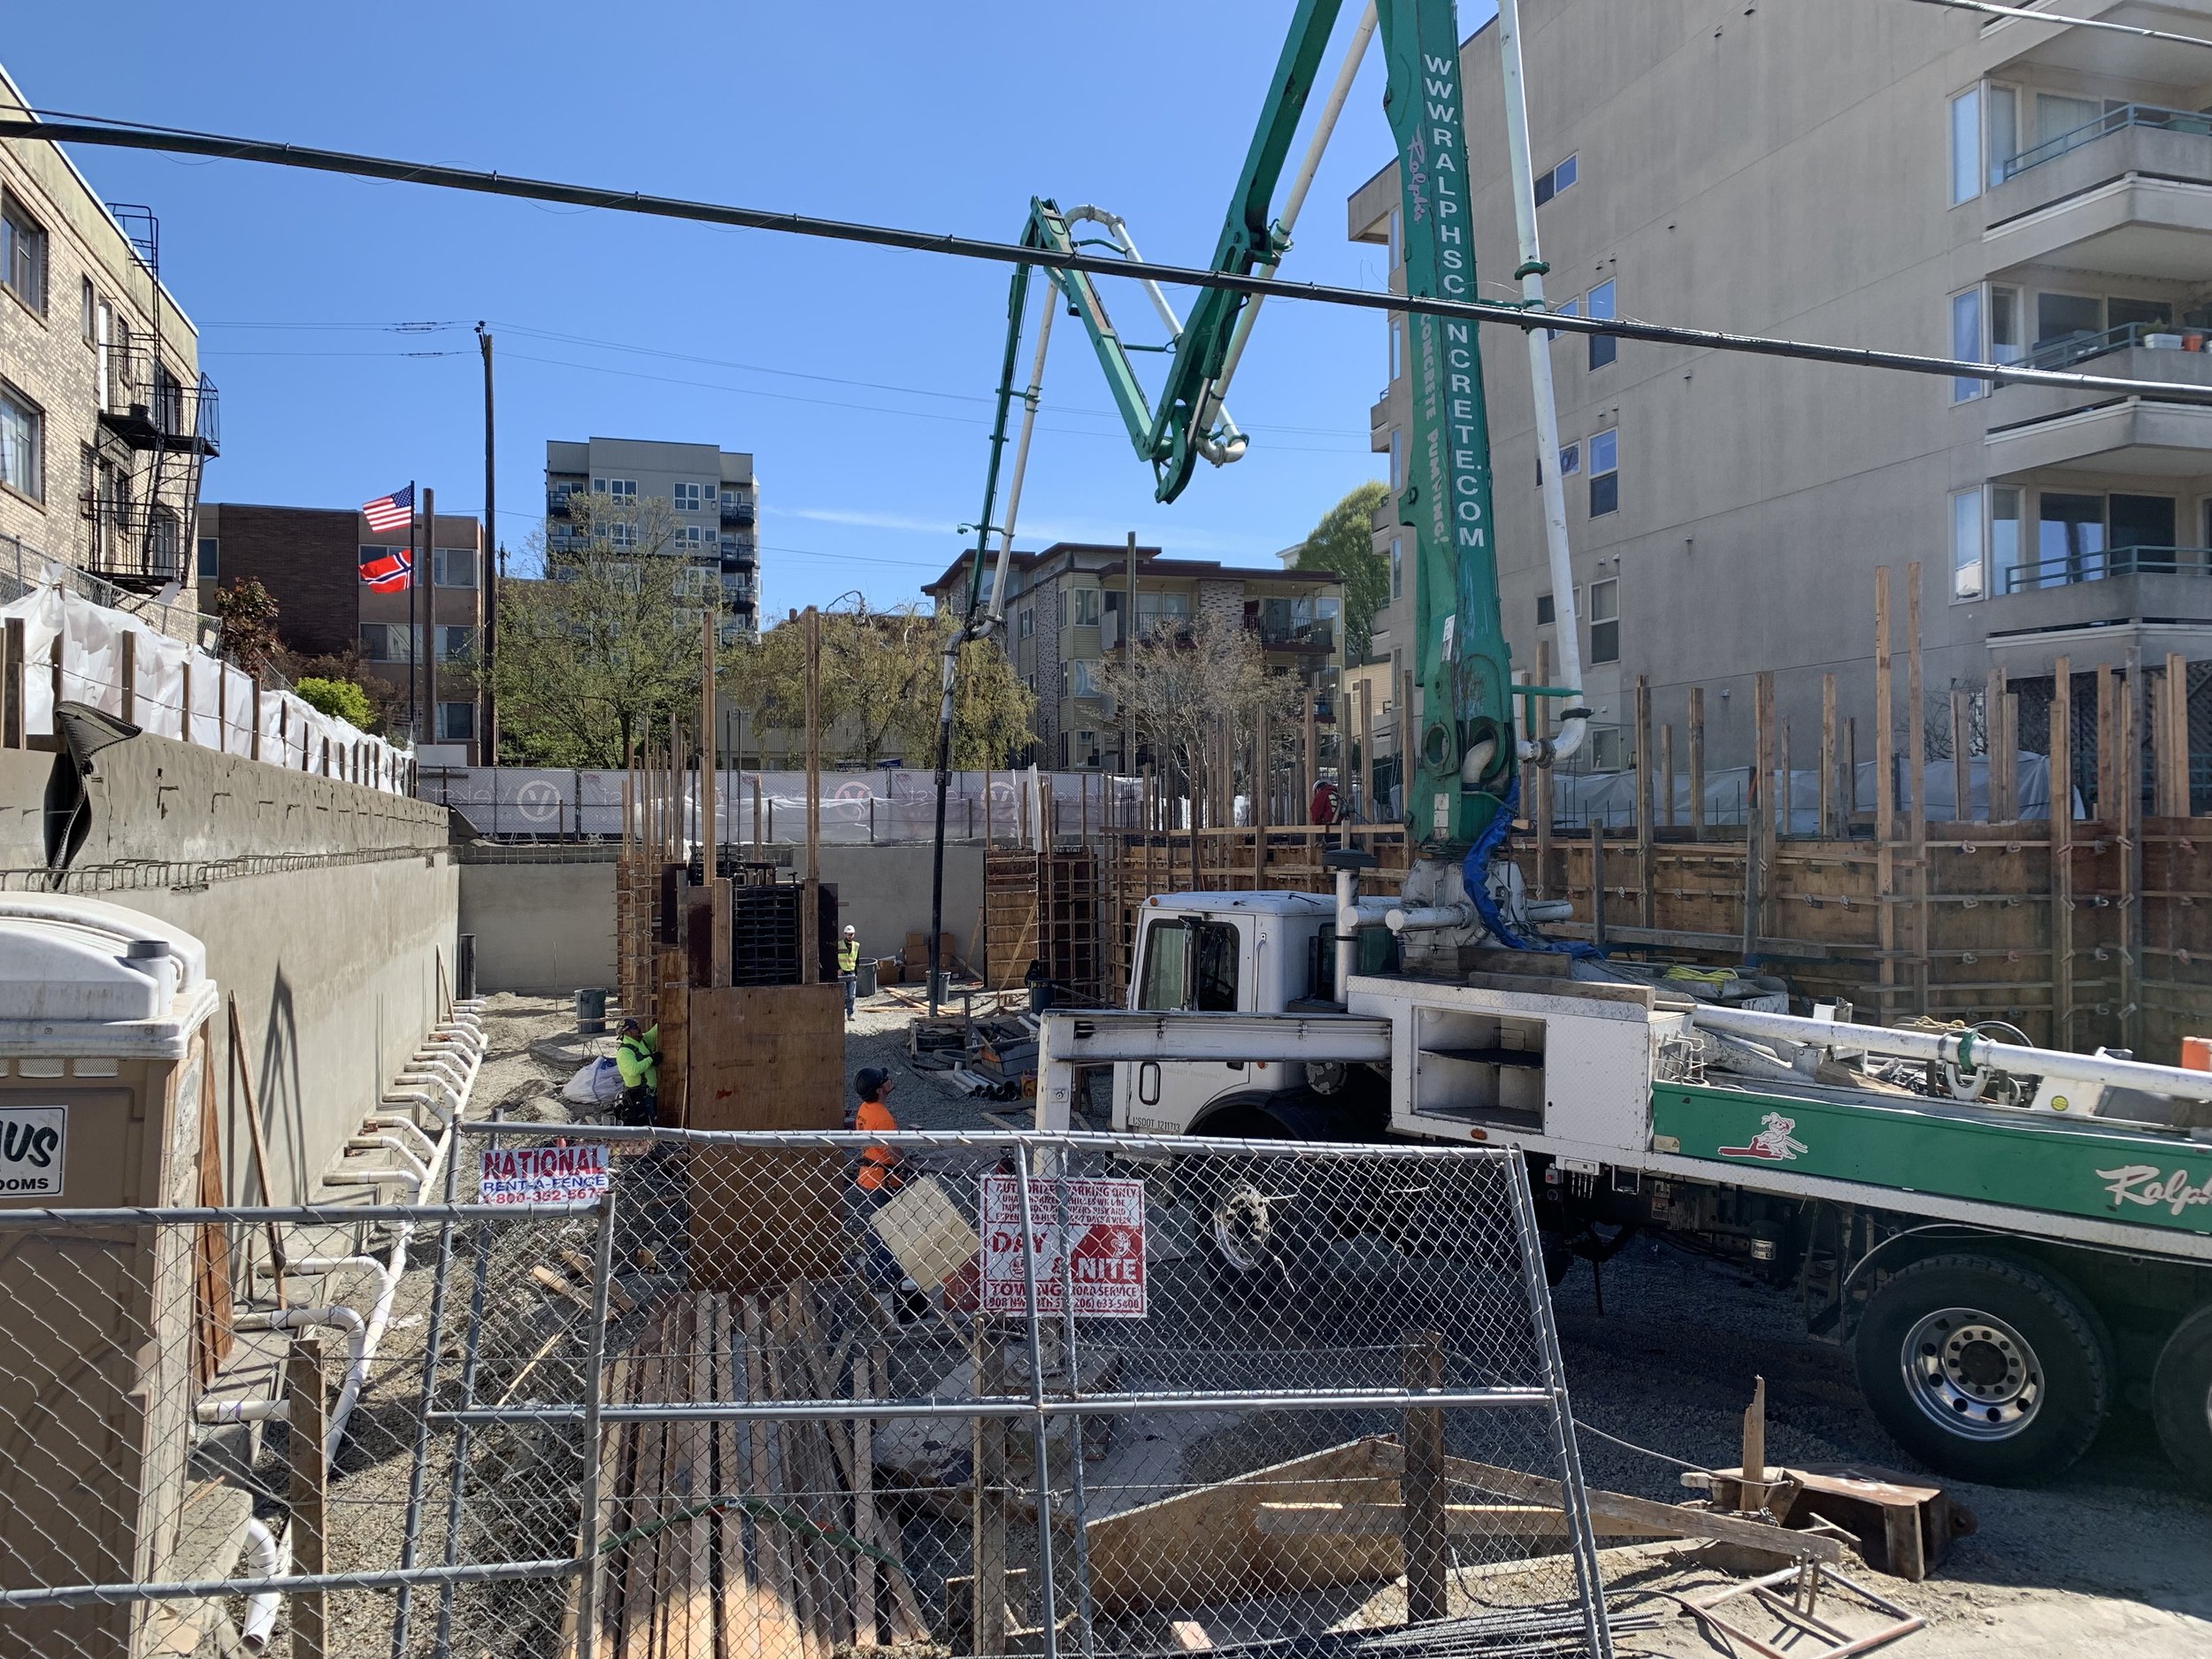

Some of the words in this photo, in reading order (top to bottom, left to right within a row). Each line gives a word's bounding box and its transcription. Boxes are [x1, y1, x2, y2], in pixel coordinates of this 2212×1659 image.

[1424, 54, 1485, 548] WWW.RALPHSCNCRETE.COM
[1426, 426, 1449, 544] PUMPING!
[1133, 1117, 1155, 1128] USDOT
[1157, 1120, 1180, 1132] 1211713
[483, 1148, 605, 1180] NATIONAL
[483, 1175, 605, 1193] RENT-A-FENCE
[996, 1184, 1058, 1194] AUTORIZE
[1111, 1187, 1136, 1198] ONLY
[992, 1232, 1048, 1253] DAY
[1077, 1257, 1137, 1279] NITE
[990, 1283, 1062, 1296] TOWNG
[1098, 1286, 1137, 1297] SERVICE
